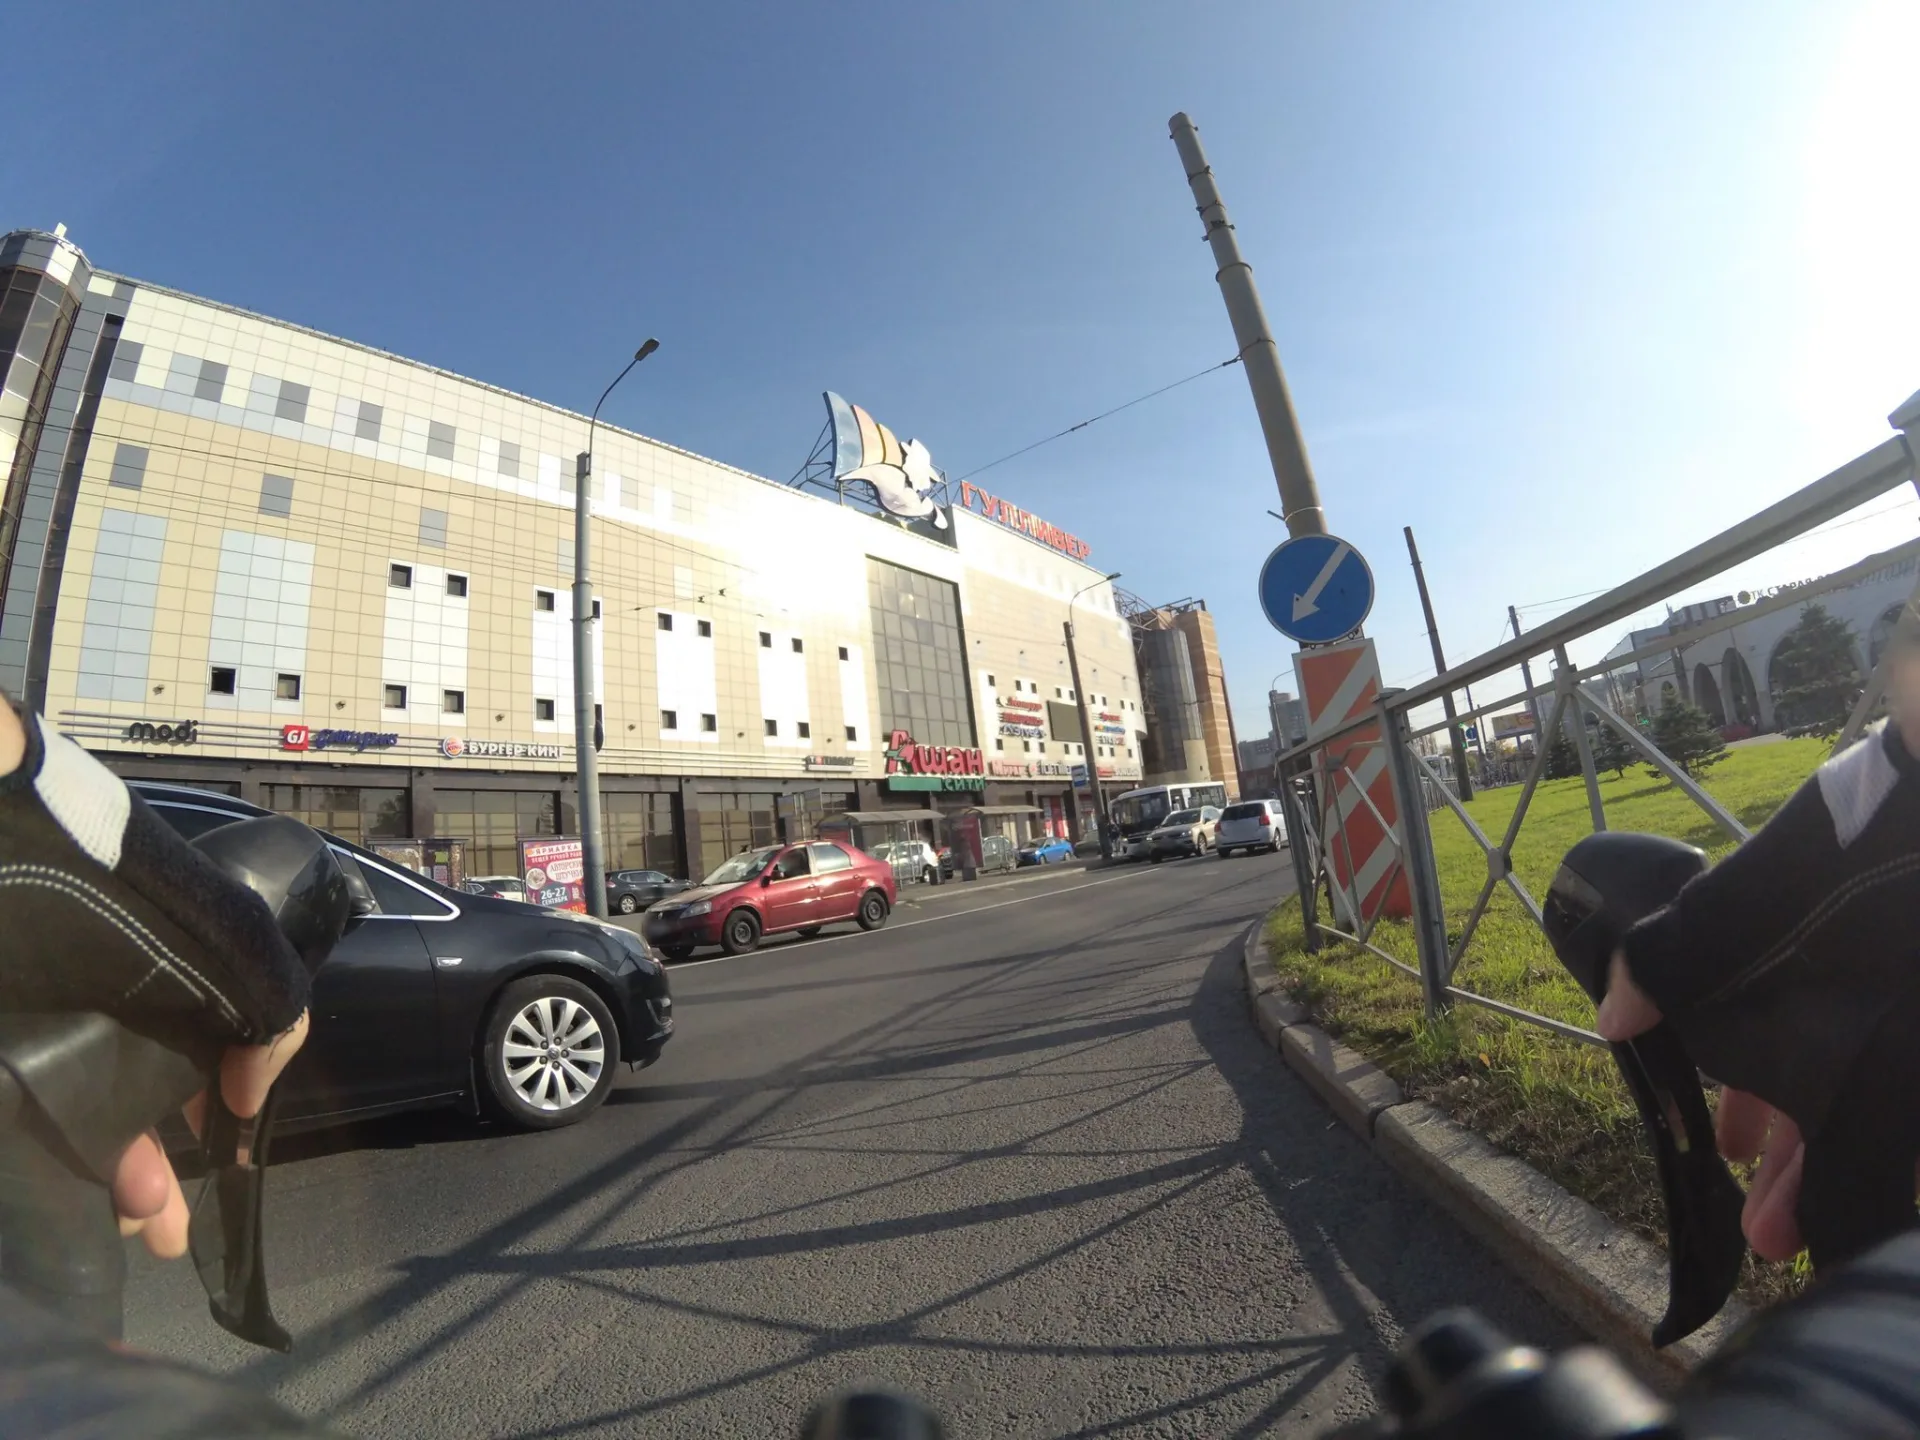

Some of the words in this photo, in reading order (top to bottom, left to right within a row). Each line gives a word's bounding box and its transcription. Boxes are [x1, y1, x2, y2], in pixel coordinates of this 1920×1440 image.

[960, 479, 1092, 561] ГУЛЛИВЕР
[129, 719, 198, 743] modi
[287, 729, 306, 745] GJ
[469, 741, 524, 757] БУРГЕР
[535, 844, 578, 854] ЯРМАРКА
[541, 887, 566, 900] 26-27
